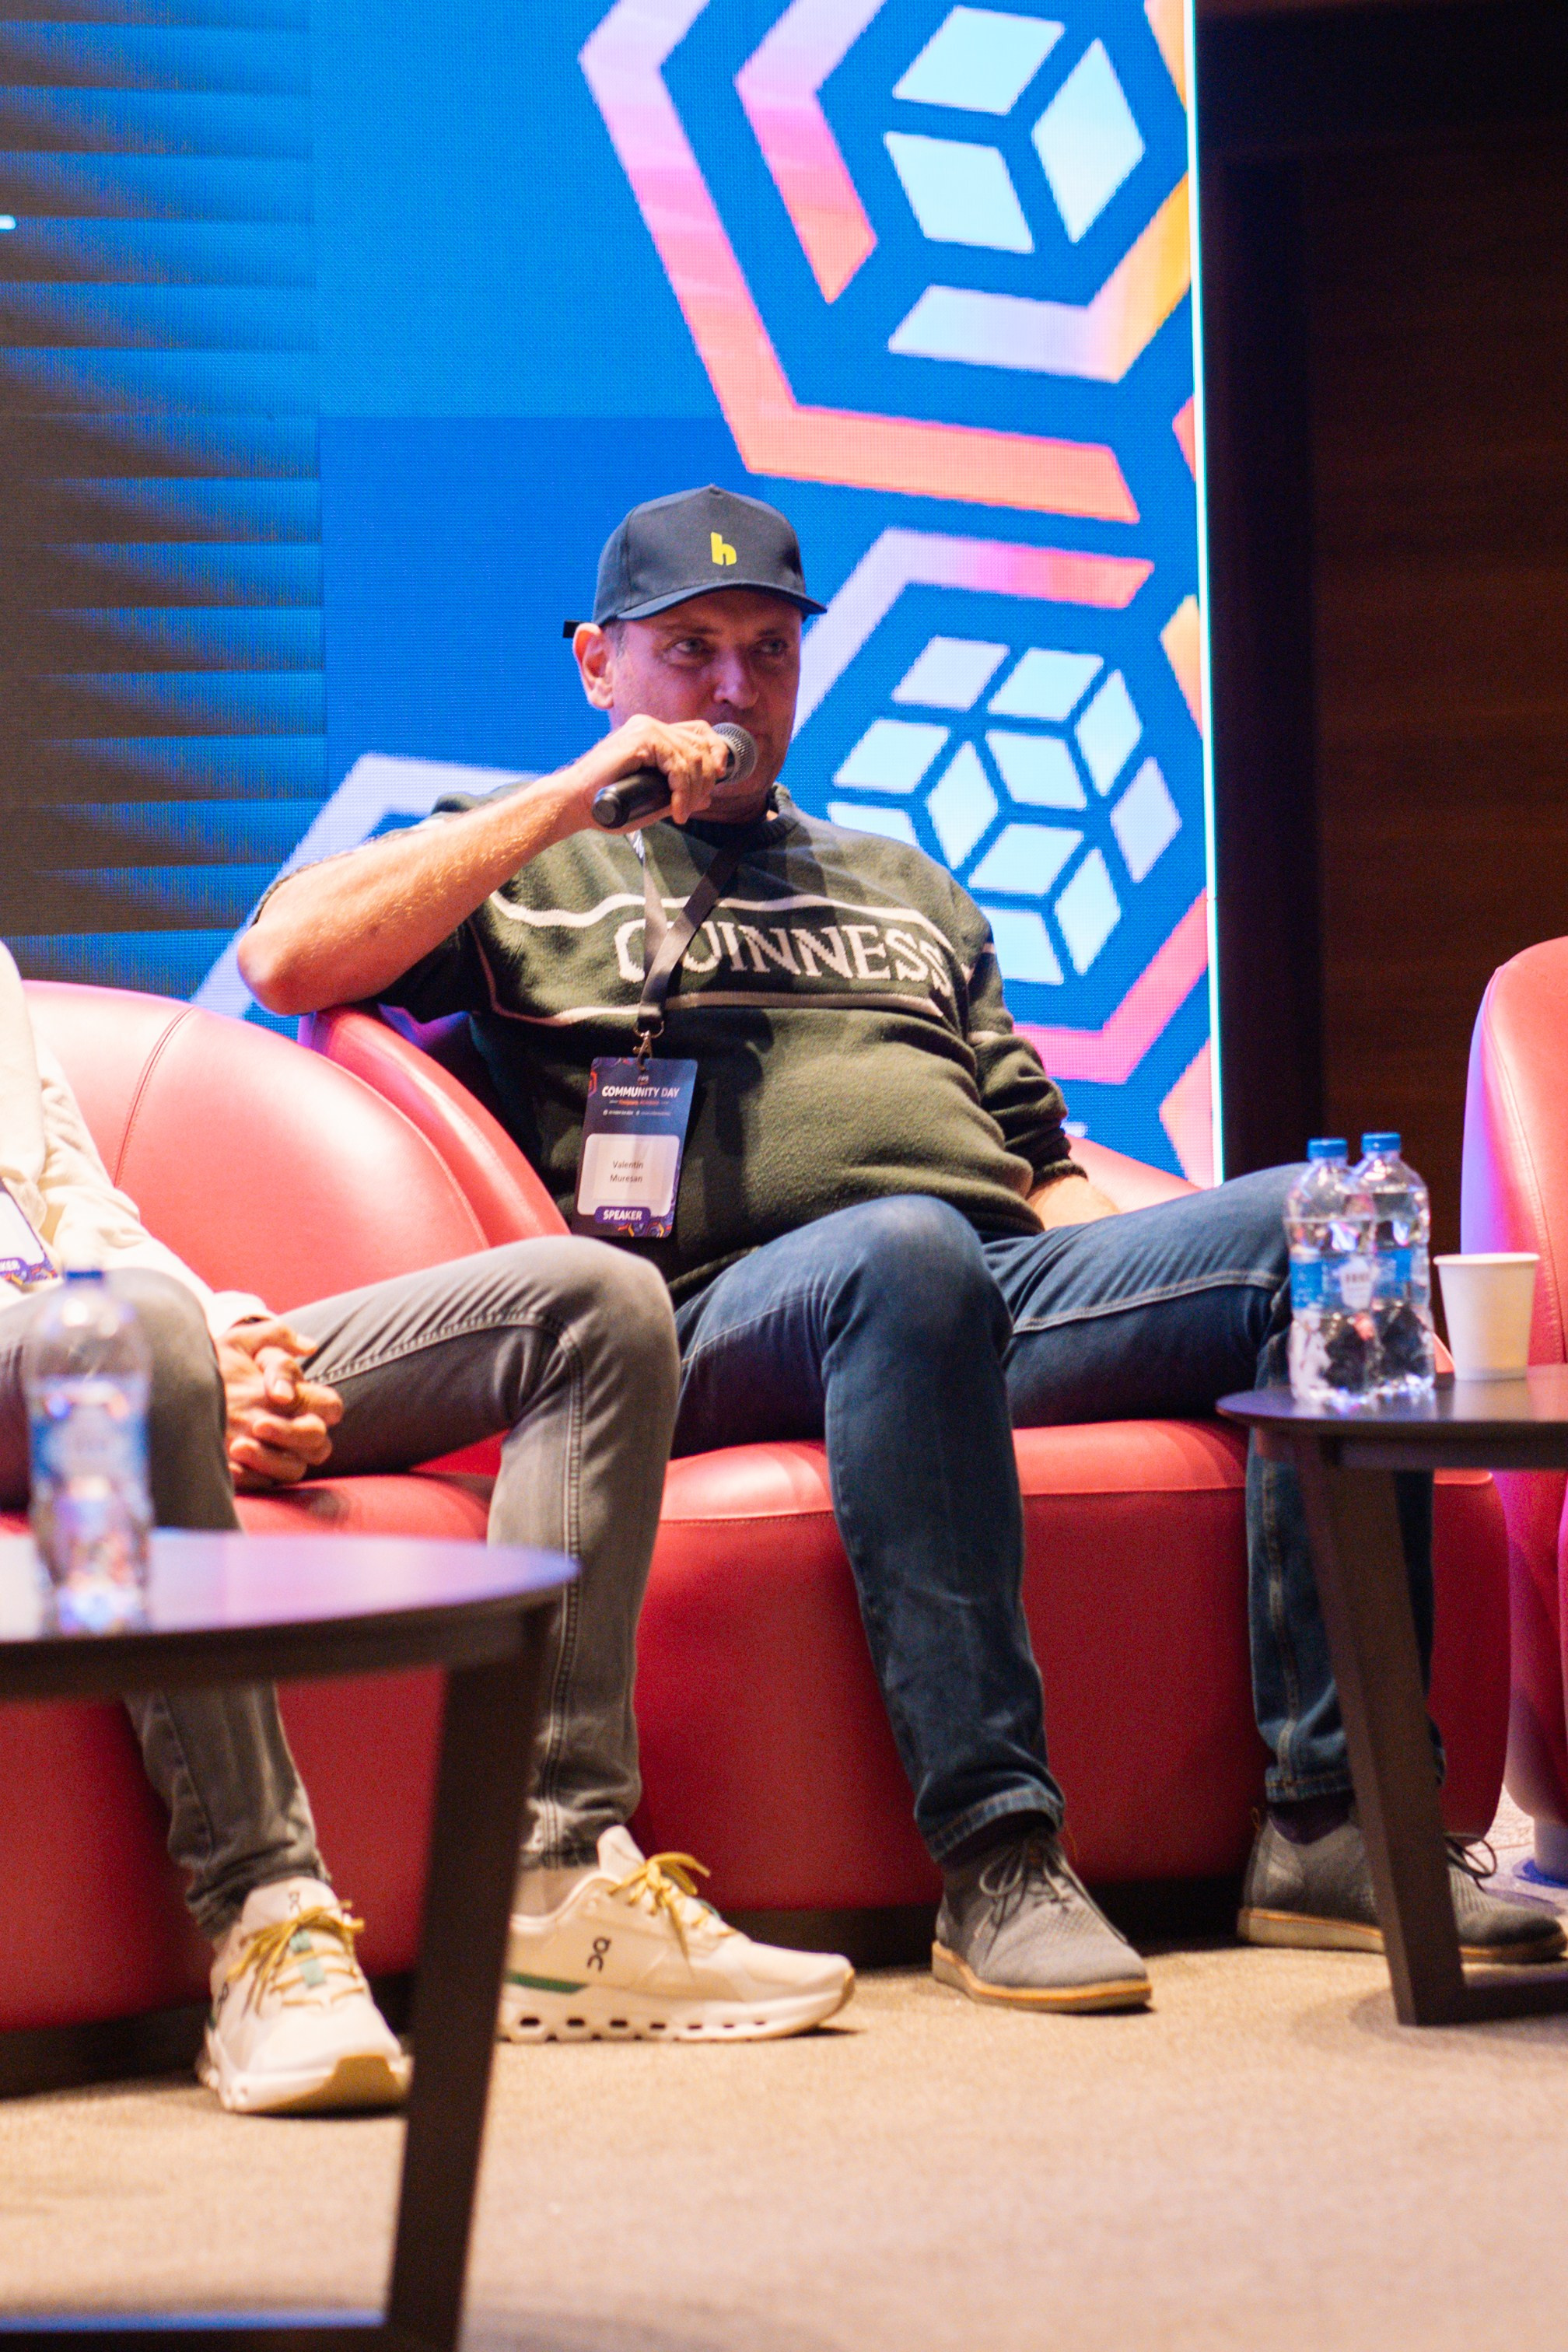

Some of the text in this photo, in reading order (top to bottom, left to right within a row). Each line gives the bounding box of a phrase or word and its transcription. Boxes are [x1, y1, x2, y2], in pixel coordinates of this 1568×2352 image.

[602, 1086, 681, 1098] COMMUNITY DAY
[613, 1160, 643, 1169] Valentin
[603, 1209, 642, 1220] SPEAKER
